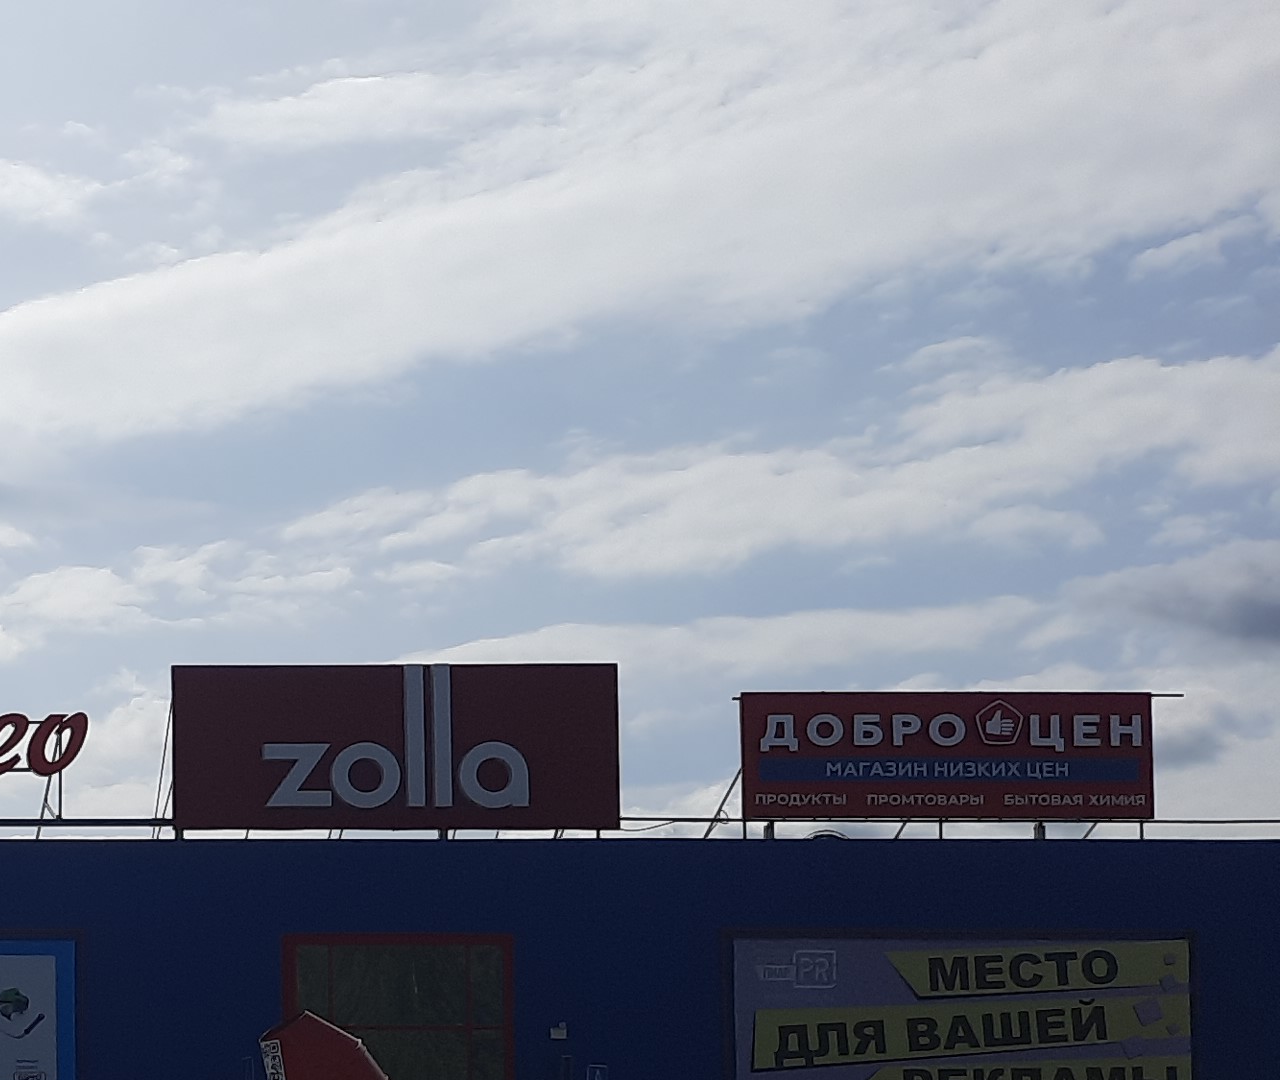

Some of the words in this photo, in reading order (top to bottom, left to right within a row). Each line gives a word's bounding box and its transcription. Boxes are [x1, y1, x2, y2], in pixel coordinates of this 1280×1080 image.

[261, 664, 530, 809] zolla
[826, 761, 928, 778] МАГАЗИН
[933, 761, 1022, 778] НИЗКИХ
[1025, 761, 1070, 780] ЦЕН
[755, 793, 848, 808] ПРОДУКТЫ
[866, 793, 985, 807] ПРОМТОВАРЫ
[1003, 793, 1084, 808] БЫТОВАЯ
[1088, 793, 1147, 808] ХИМИЯ
[927, 950, 1119, 992] МЕСТО
[774, 1019, 887, 1068] ДЛЯ
[906, 998, 1109, 1053] ВАШЕЙ
